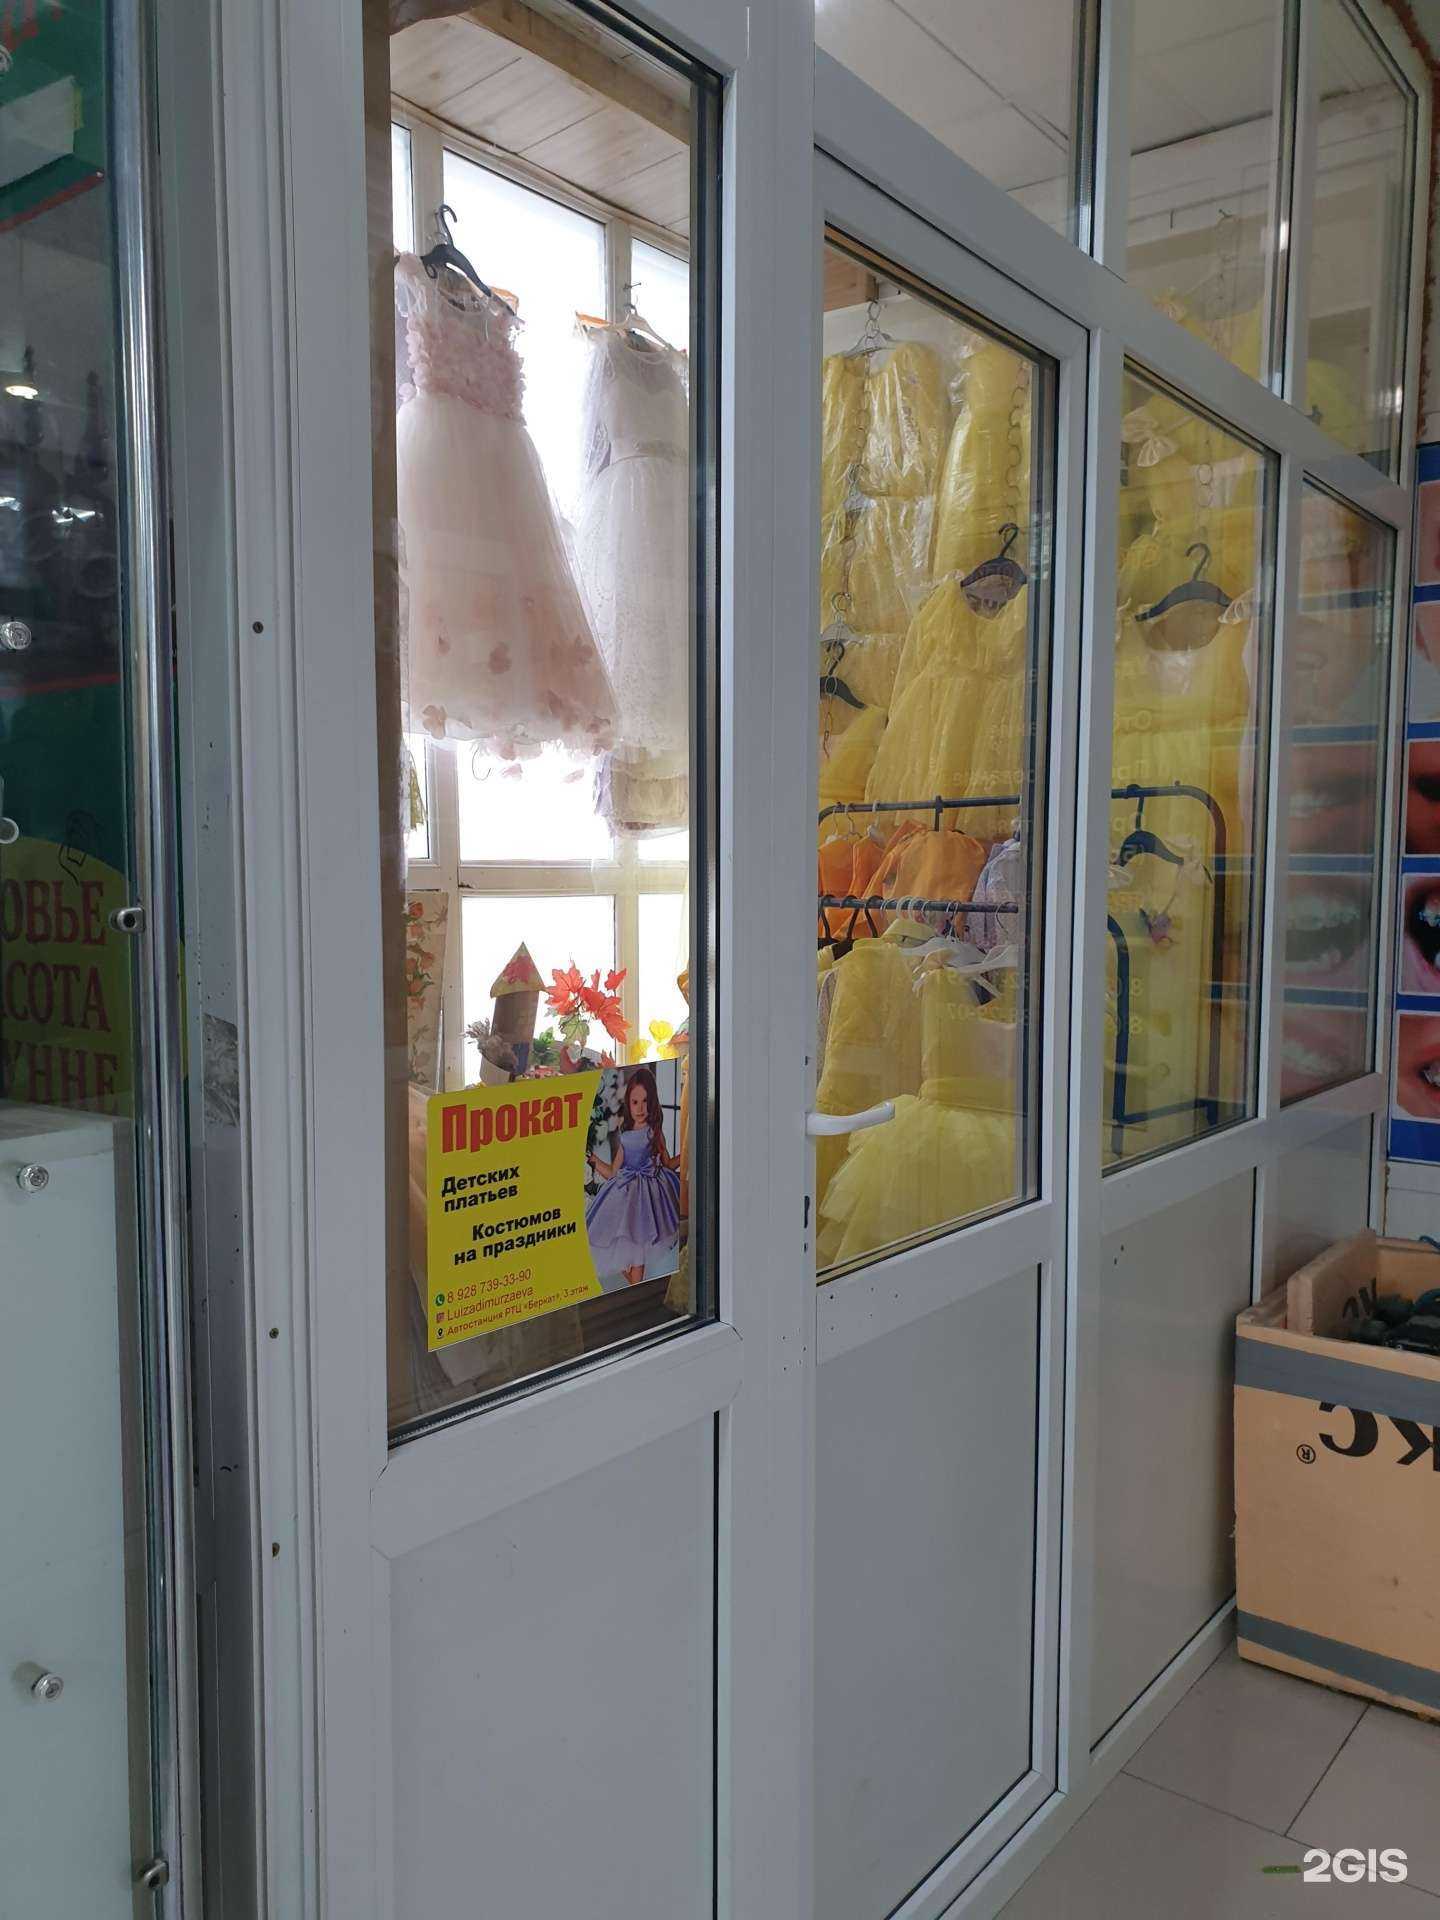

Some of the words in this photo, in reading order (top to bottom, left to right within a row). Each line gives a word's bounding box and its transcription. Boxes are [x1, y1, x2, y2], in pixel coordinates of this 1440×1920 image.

[442, 1092, 583, 1153] Прокат
[441, 1166, 520, 1197] Детских
[444, 1185, 518, 1212] платьев
[472, 1208, 561, 1241] Костюмов
[454, 1249, 477, 1265] на
[482, 1222, 577, 1258] праздники
[447, 1291, 454, 1304] 8
[457, 1284, 477, 1301] 928
[480, 1269, 532, 1294] 739-33-90
[447, 1311, 503, 1335] Автостанция
[504, 1304, 522, 1317] РТЦ
[569, 1285, 589, 1297] этаж
